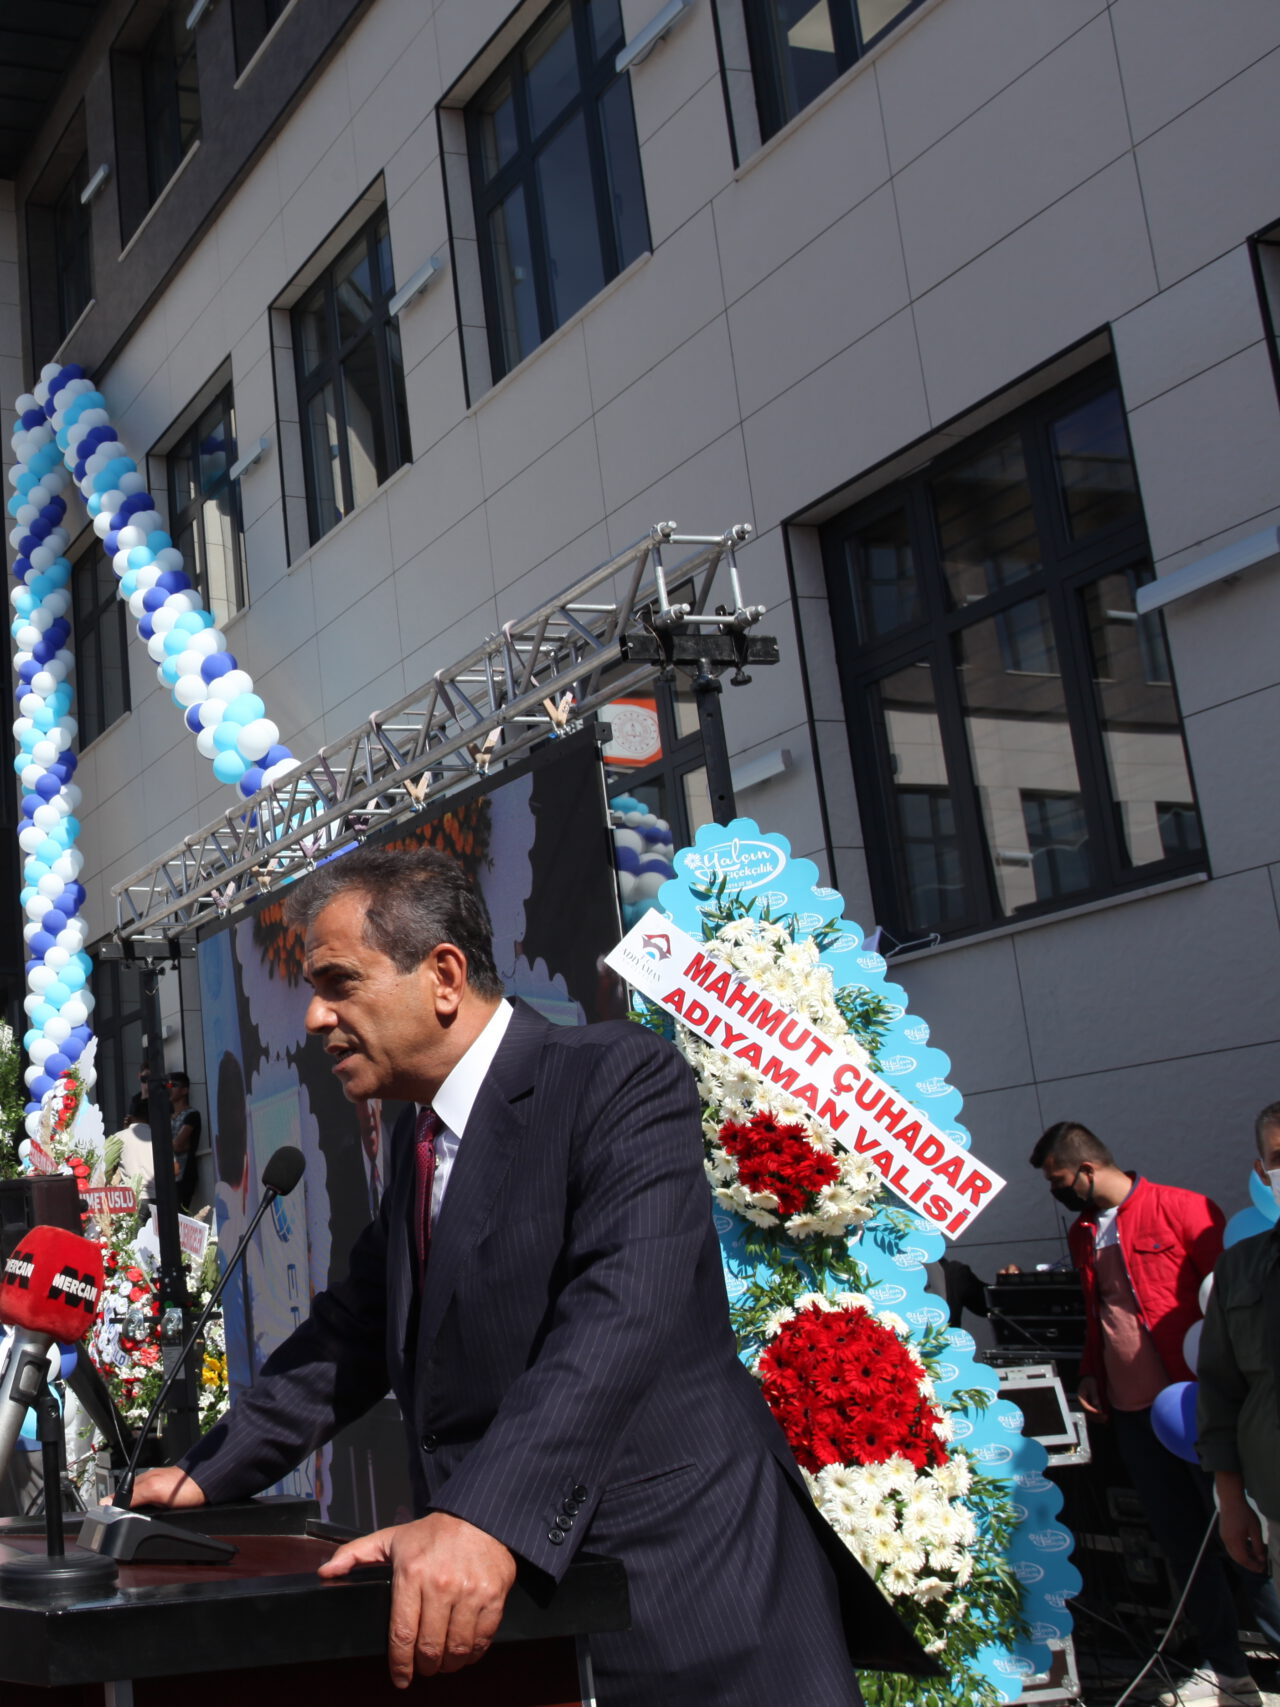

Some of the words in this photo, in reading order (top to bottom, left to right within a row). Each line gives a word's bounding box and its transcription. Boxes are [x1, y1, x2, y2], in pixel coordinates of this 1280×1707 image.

[661, 987, 849, 1131] ADIYAMAN
[853, 1126, 971, 1235] VALİSİ
[683, 951, 833, 1066] MAHMUT
[831, 1063, 993, 1207] ÇUHADAR
[107, 1191, 134, 1209] USLU
[51, 1273, 98, 1302] MERCAN
